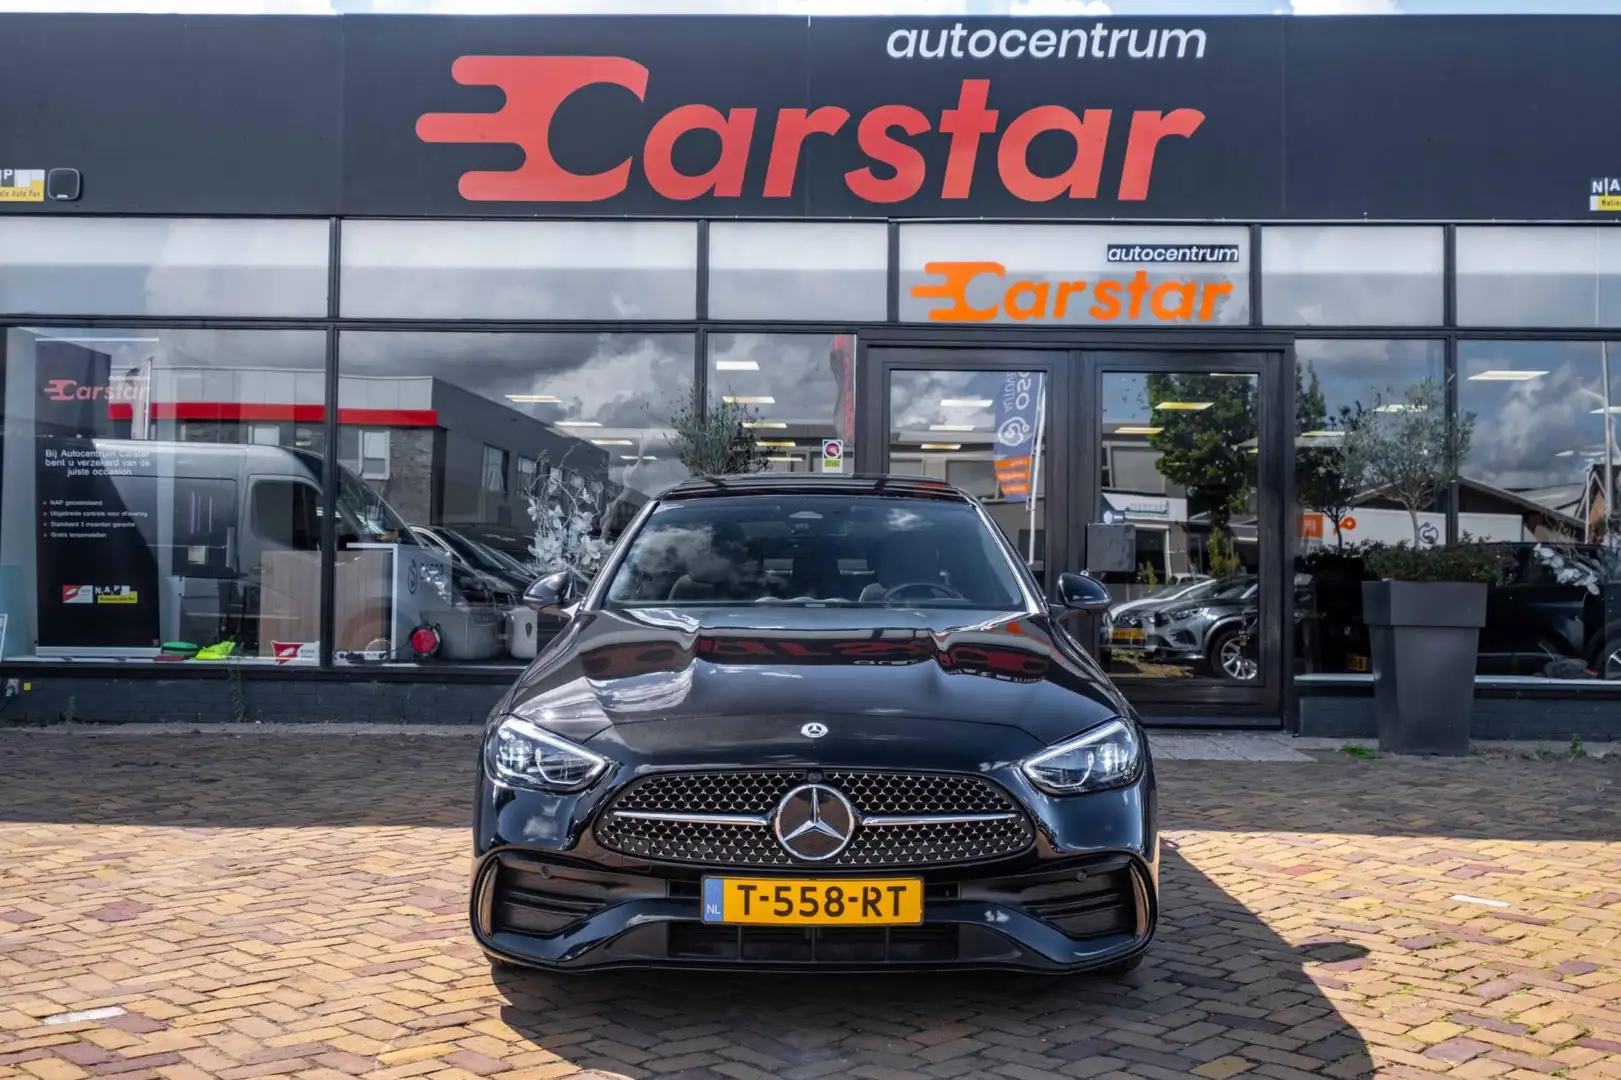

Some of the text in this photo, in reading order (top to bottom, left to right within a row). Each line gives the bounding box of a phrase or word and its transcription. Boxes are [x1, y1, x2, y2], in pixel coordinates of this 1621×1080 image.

[886, 22, 1207, 59] autocentrum
[414, 55, 1206, 203] Carstar
[1107, 245, 1239, 261] autocentrum
[910, 262, 1234, 322] Carstar
[43, 379, 149, 401] Carstar
[45, 449, 58, 459] Bij
[60, 449, 116, 458] Autocentrum
[45, 459, 65, 467] bent
[77, 459, 119, 467] verzekerd
[140, 459, 150, 467] de
[67, 468, 132, 478] juiste occasion
[706, 904, 721, 915] NL
[737, 884, 907, 918] T-558-RT
